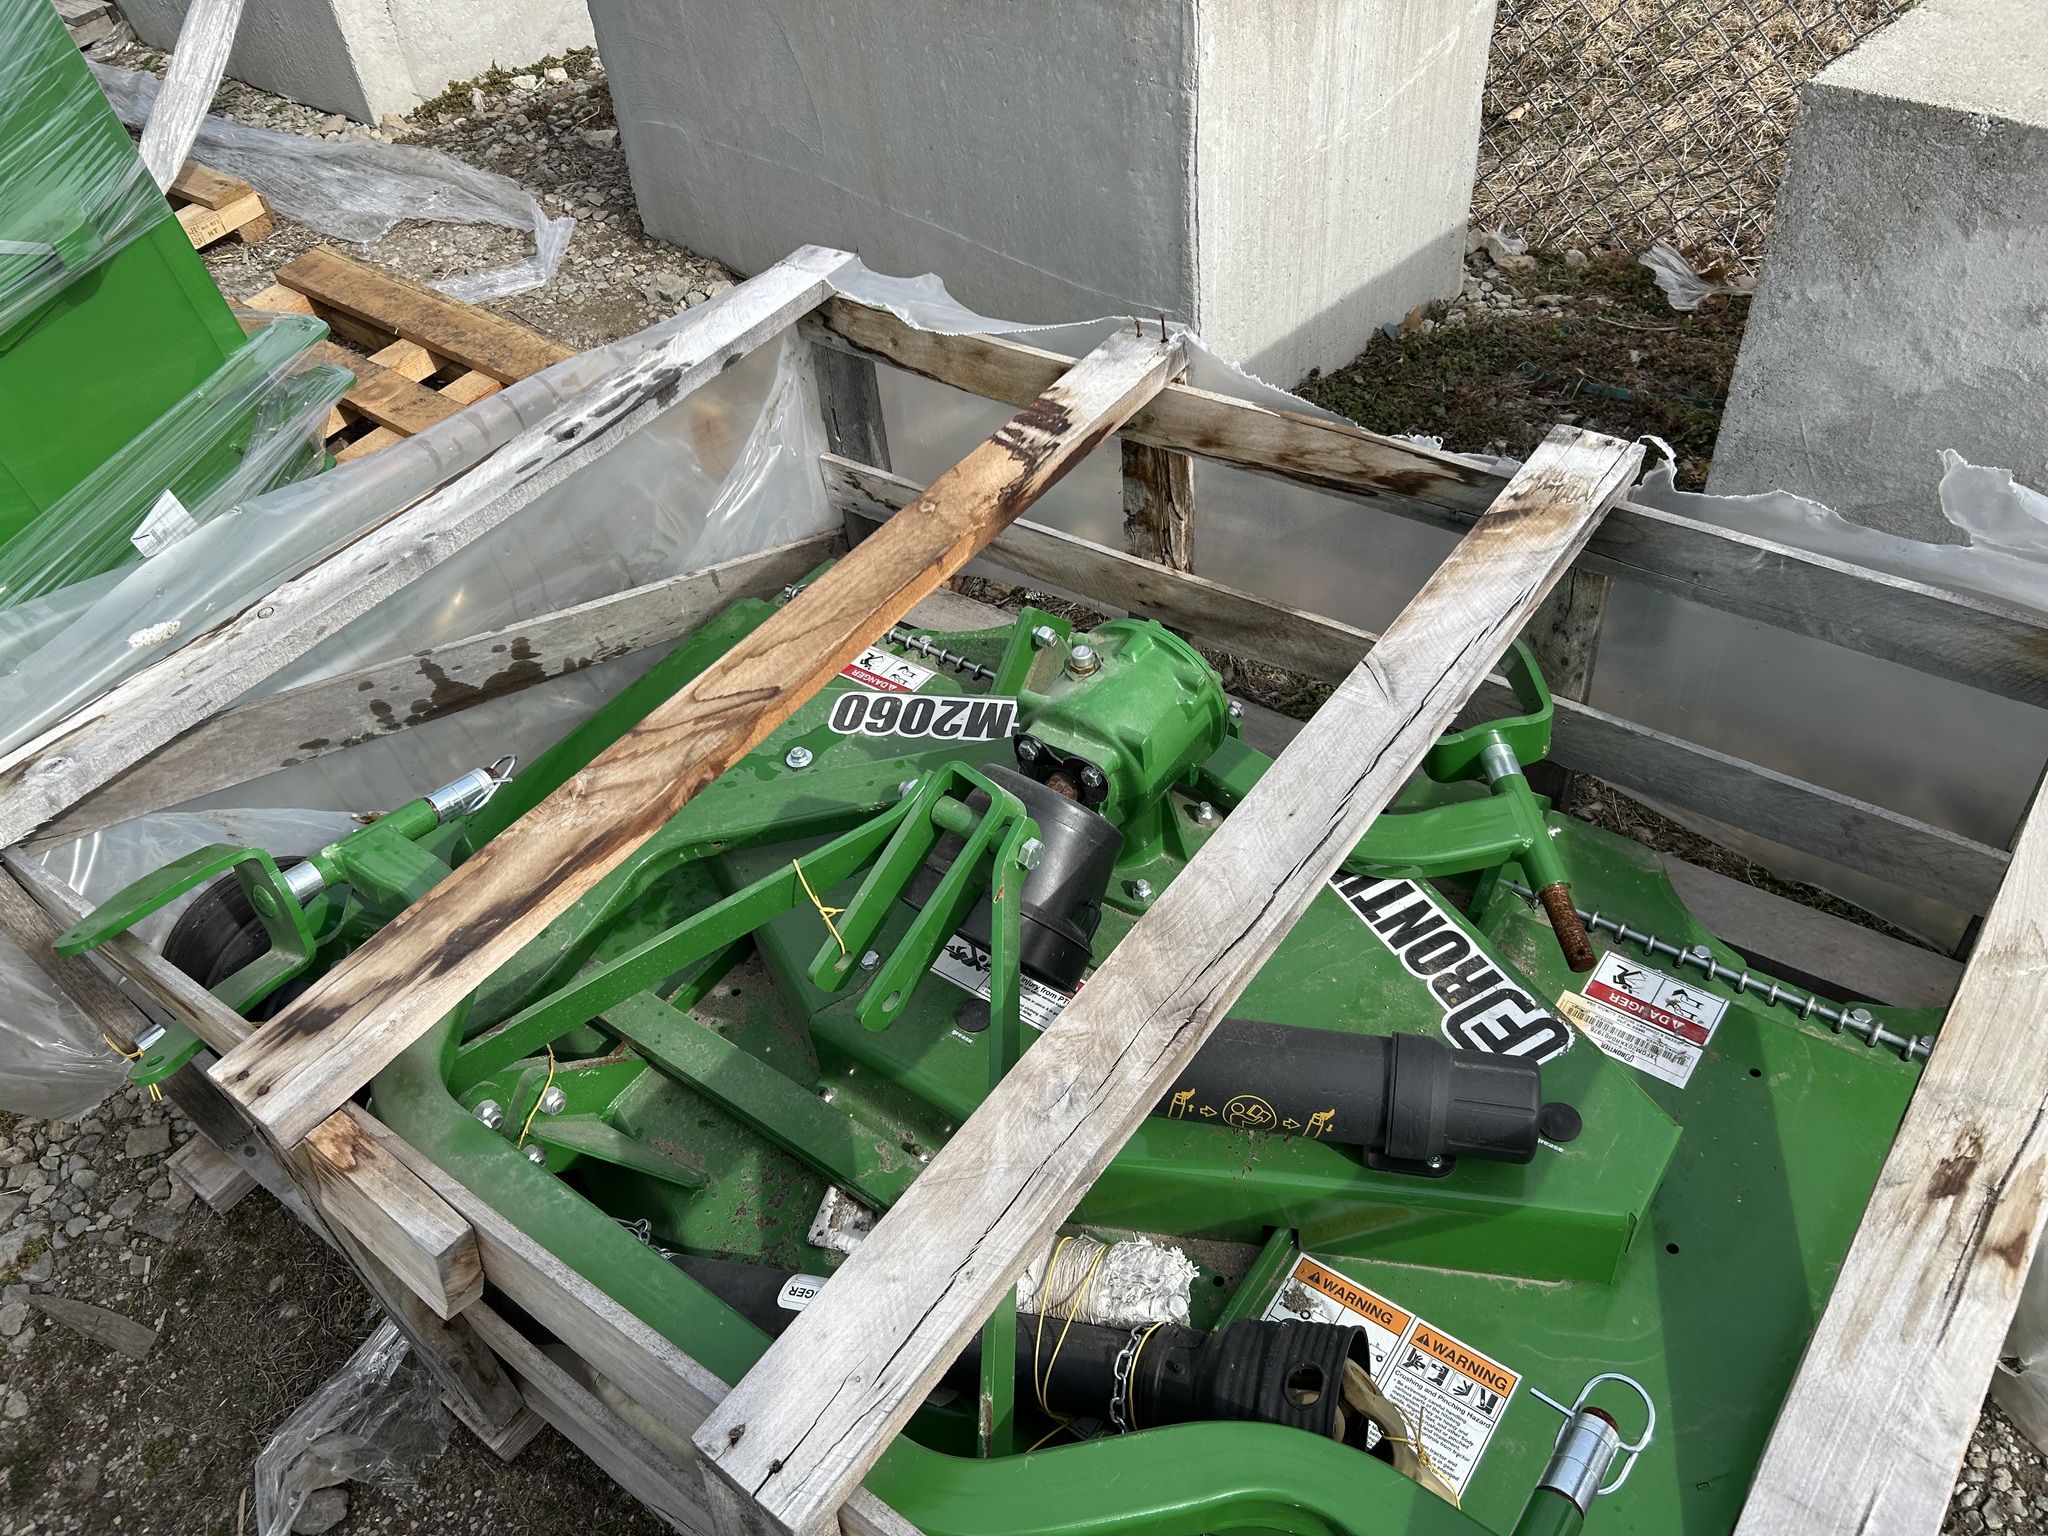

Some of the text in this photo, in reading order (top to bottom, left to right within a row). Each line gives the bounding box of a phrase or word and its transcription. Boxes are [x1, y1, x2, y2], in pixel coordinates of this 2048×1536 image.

[207, 228, 218, 236] HT
[851, 669, 889, 688] DANGER
[1021, 977, 1040, 990] injury
[1041, 987, 1057, 999] from
[1598, 1043, 1634, 1062] FRONTIER
[789, 1286, 819, 1298] GER
[1323, 1278, 1392, 1325] WARNING
[1433, 1340, 1507, 1391] WARNING
[1395, 1370, 1491, 1428] Crushing and Pinching Hazard
